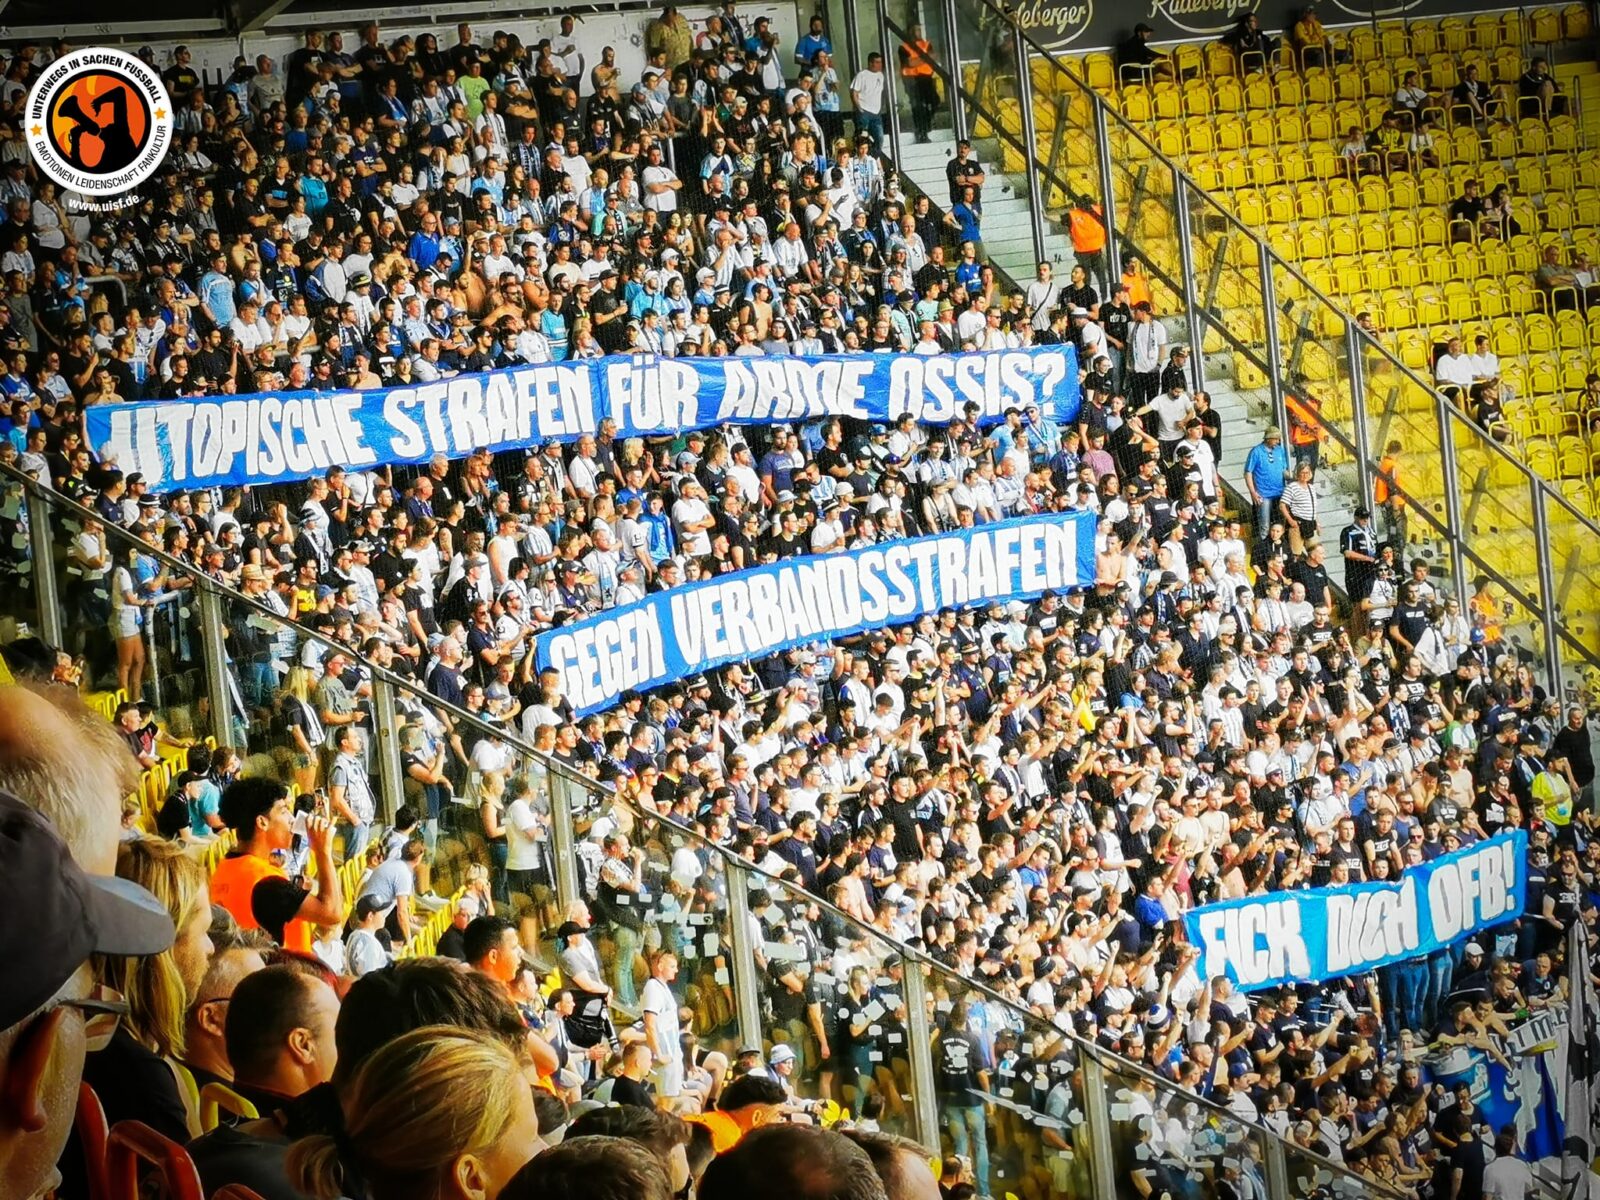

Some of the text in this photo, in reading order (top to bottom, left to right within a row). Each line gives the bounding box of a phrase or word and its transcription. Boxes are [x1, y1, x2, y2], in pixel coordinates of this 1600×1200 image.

[107, 353, 1065, 487] UTOPISCHE STRAFEN FÜR ARME OSSIS?
[549, 521, 1078, 709] GEGEN VERBANDSSTRAFEN
[1199, 839, 1516, 985] FICK DICH OFB!
